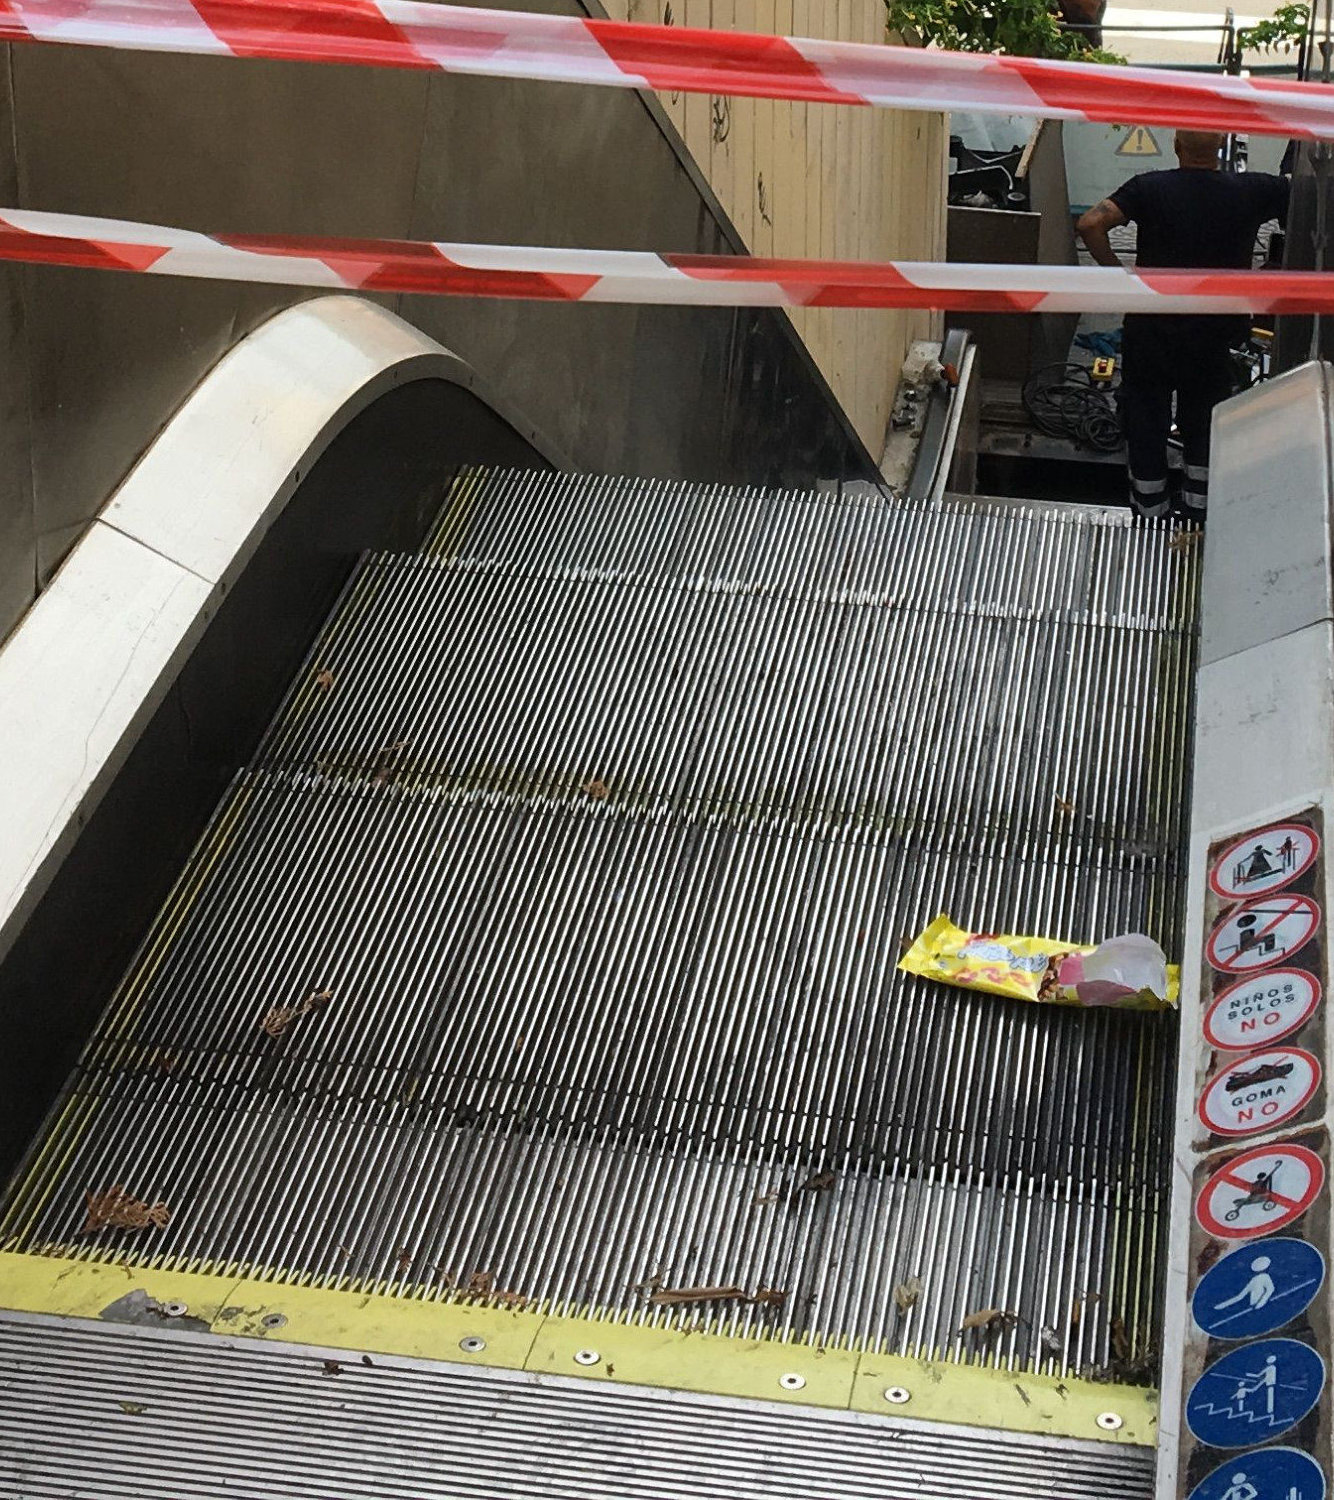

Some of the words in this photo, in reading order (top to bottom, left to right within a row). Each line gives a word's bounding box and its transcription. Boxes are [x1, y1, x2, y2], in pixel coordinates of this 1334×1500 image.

[1228, 994, 1295, 1020] SOLOS
[1241, 1012, 1280, 1032] NO
[1232, 1085, 1286, 1107] GOMA
[1238, 1102, 1279, 1123] NO
